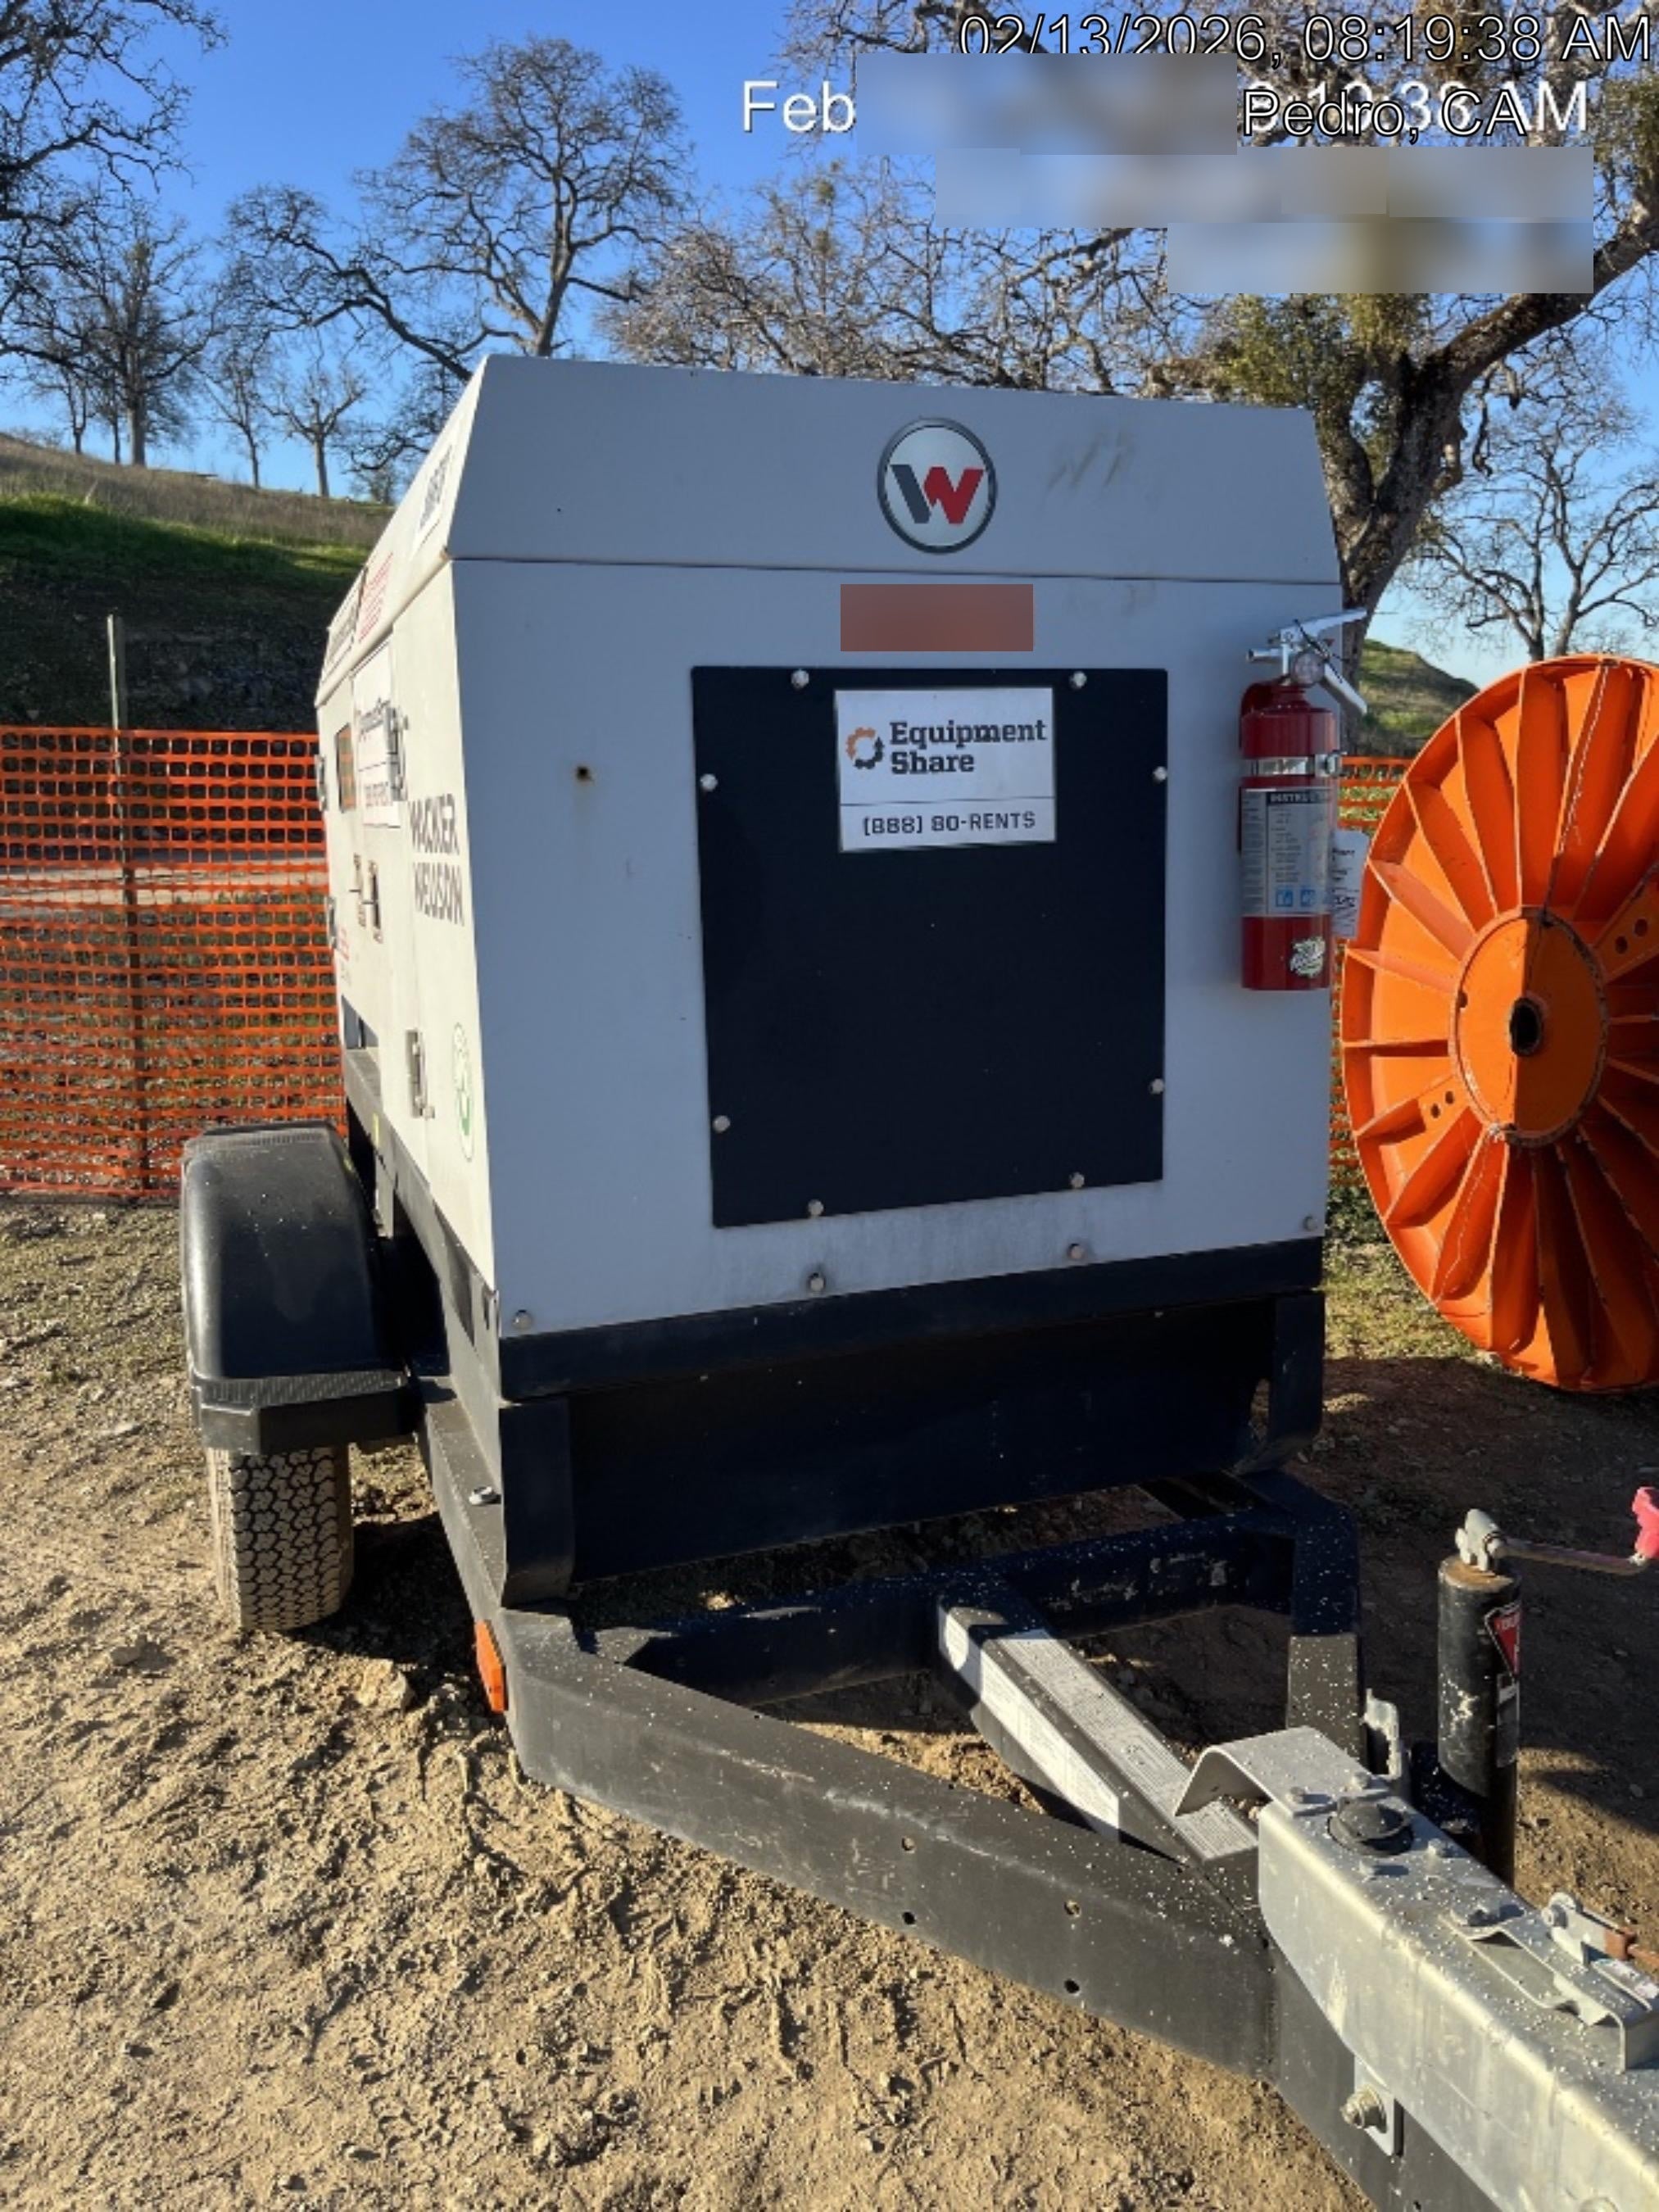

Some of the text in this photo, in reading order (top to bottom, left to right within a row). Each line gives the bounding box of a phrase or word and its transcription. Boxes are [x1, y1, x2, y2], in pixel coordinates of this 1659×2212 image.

[889, 719, 1048, 750] Equipment
[891, 750, 975, 775] Share
[931, 810, 1036, 832] 80-RENTS
